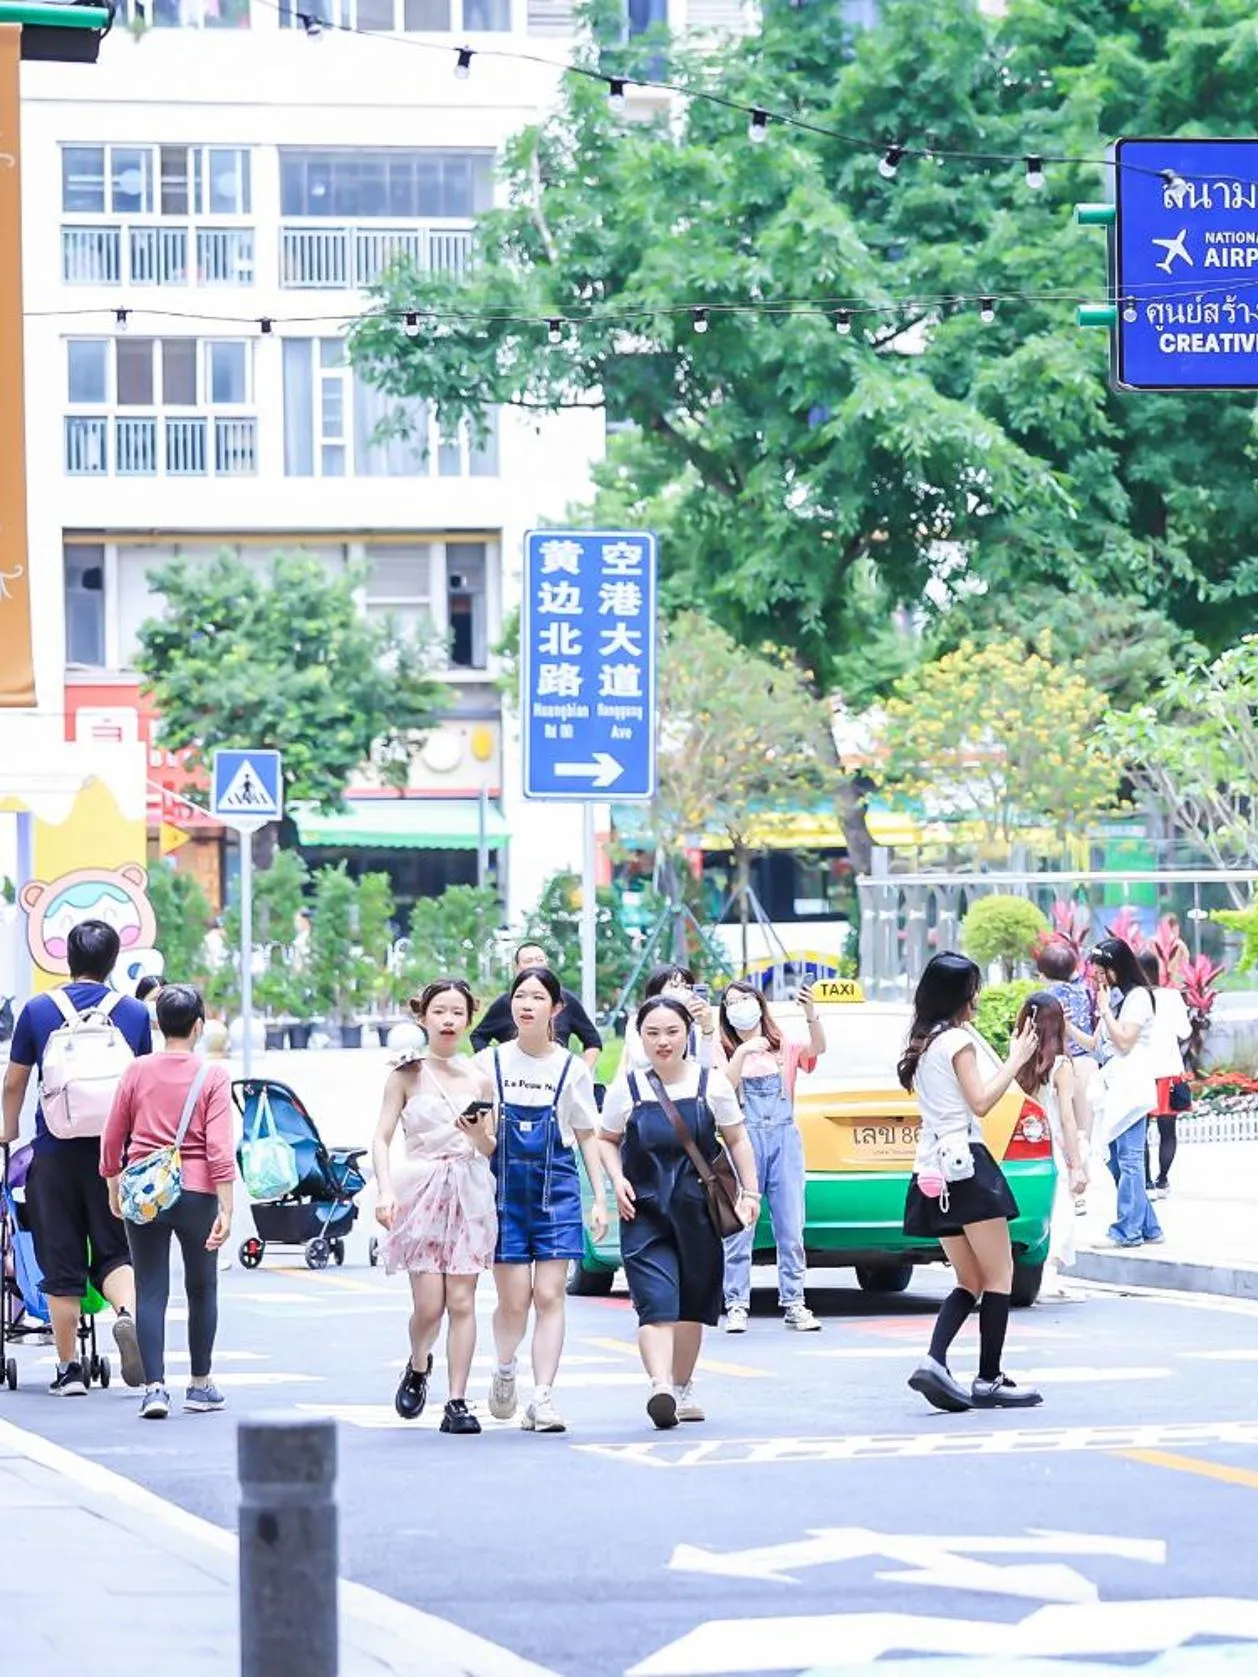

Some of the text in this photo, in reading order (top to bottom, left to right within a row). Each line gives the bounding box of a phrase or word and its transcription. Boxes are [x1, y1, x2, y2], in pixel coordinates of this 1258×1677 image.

[537, 540, 584, 697] 黄边北路
[598, 541, 643, 697] 空港大道
[820, 984, 854, 996] TAXI
